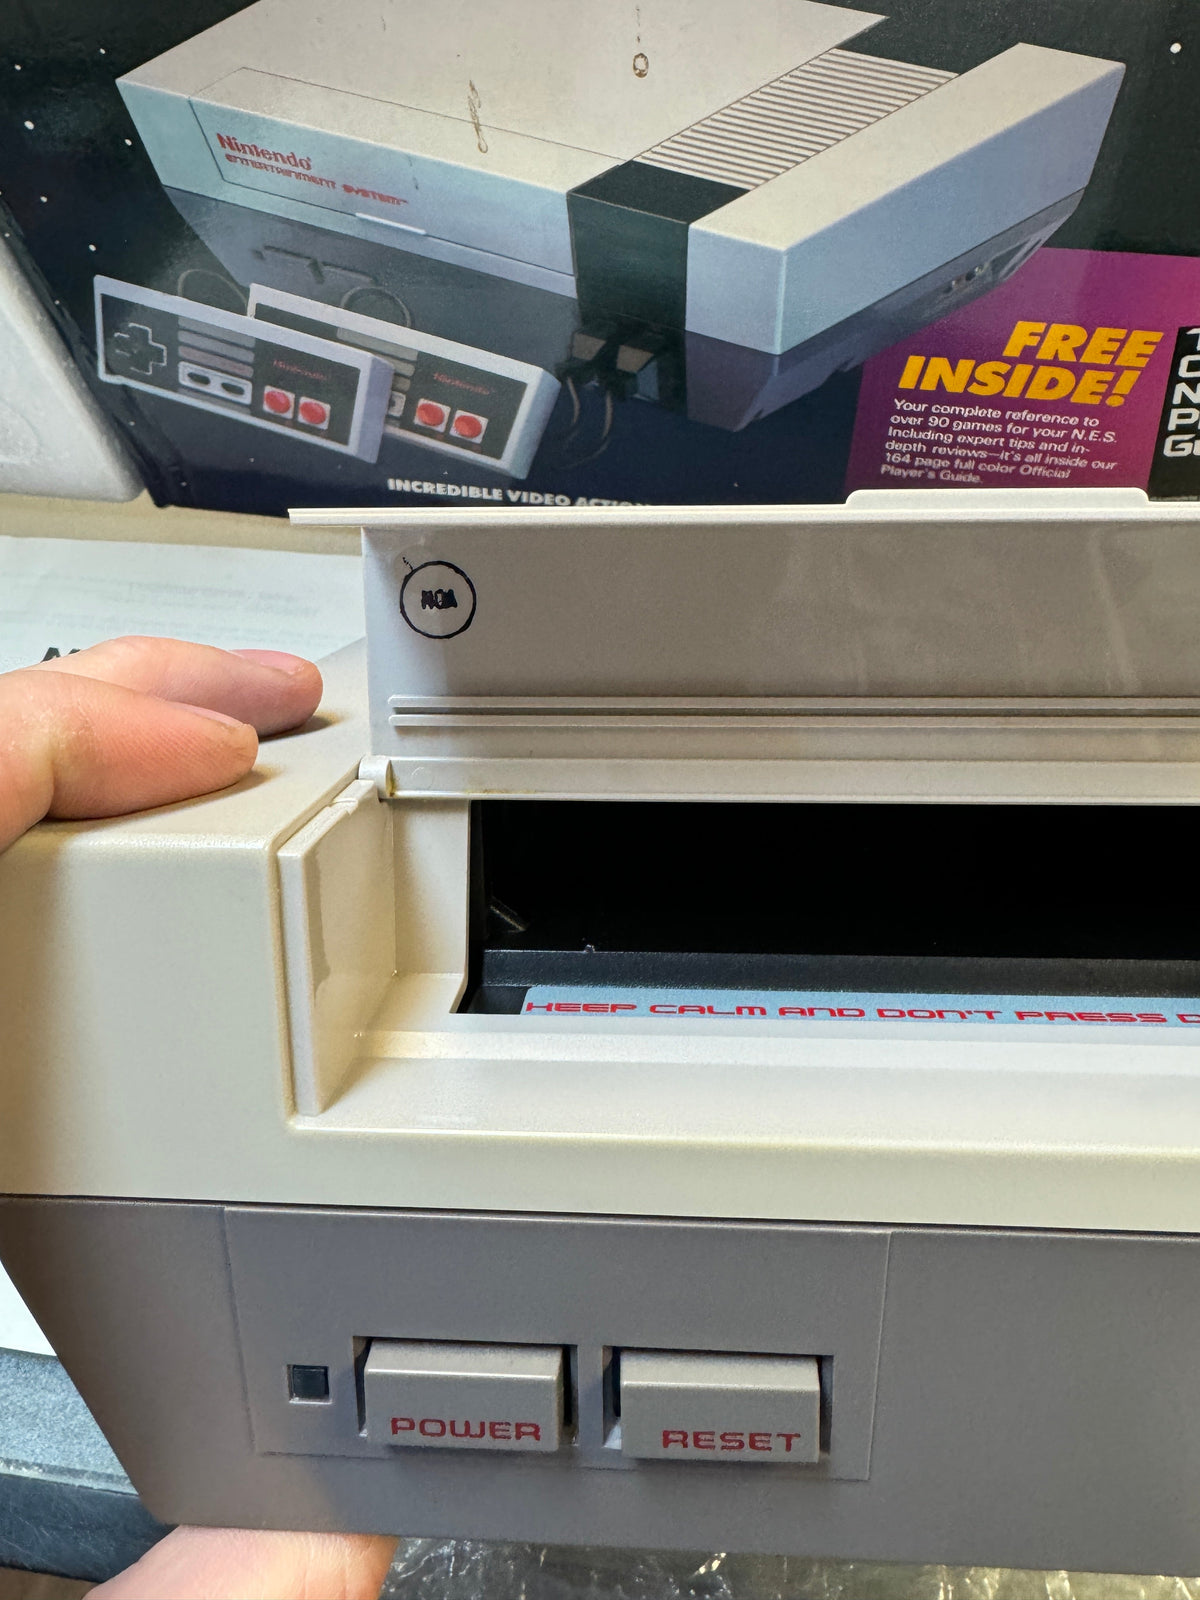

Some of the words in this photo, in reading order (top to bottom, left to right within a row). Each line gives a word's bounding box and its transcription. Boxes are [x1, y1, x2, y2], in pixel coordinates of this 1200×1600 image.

[216, 133, 312, 171] Nintendo
[1002, 321, 1164, 368] FREE
[898, 355, 1141, 407] INSIDE!
[894, 398, 928, 412] Your
[931, 404, 1001, 418] complete
[1005, 410, 1079, 425] reference
[1083, 417, 1099, 427] to
[890, 415, 924, 425] over
[928, 416, 950, 428] 90
[952, 420, 1002, 432] games
[1006, 422, 1029, 435] for
[1033, 428, 1068, 439] your
[1070, 428, 1117, 443] N.E.S.
[885, 440, 927, 453] depth
[1025, 453, 1042, 463] all
[1044, 453, 1088, 467] inside
[1091, 460, 1118, 470] our
[957, 435, 1004, 446] expert
[1009, 437, 1035, 450] tips
[1039, 442, 1069, 452] and
[1071, 442, 1090, 454] in-
[880, 464, 936, 479] Player's
[886, 452, 911, 464] 164
[914, 457, 950, 469] page
[953, 459, 975, 470] full
[978, 462, 1016, 473] color
[1020, 464, 1071, 478] Official
[387, 478, 503, 501] INCREDIBLE
[506, 489, 571, 506] VIDEO
[650, 1004, 767, 1016] CALM
[778, 1006, 865, 1017] AND
[876, 1008, 1002, 1020] DON'T
[1015, 1011, 1167, 1023] PRESS
[390, 1417, 542, 1442] POWER
[661, 1429, 802, 1453] RESET
